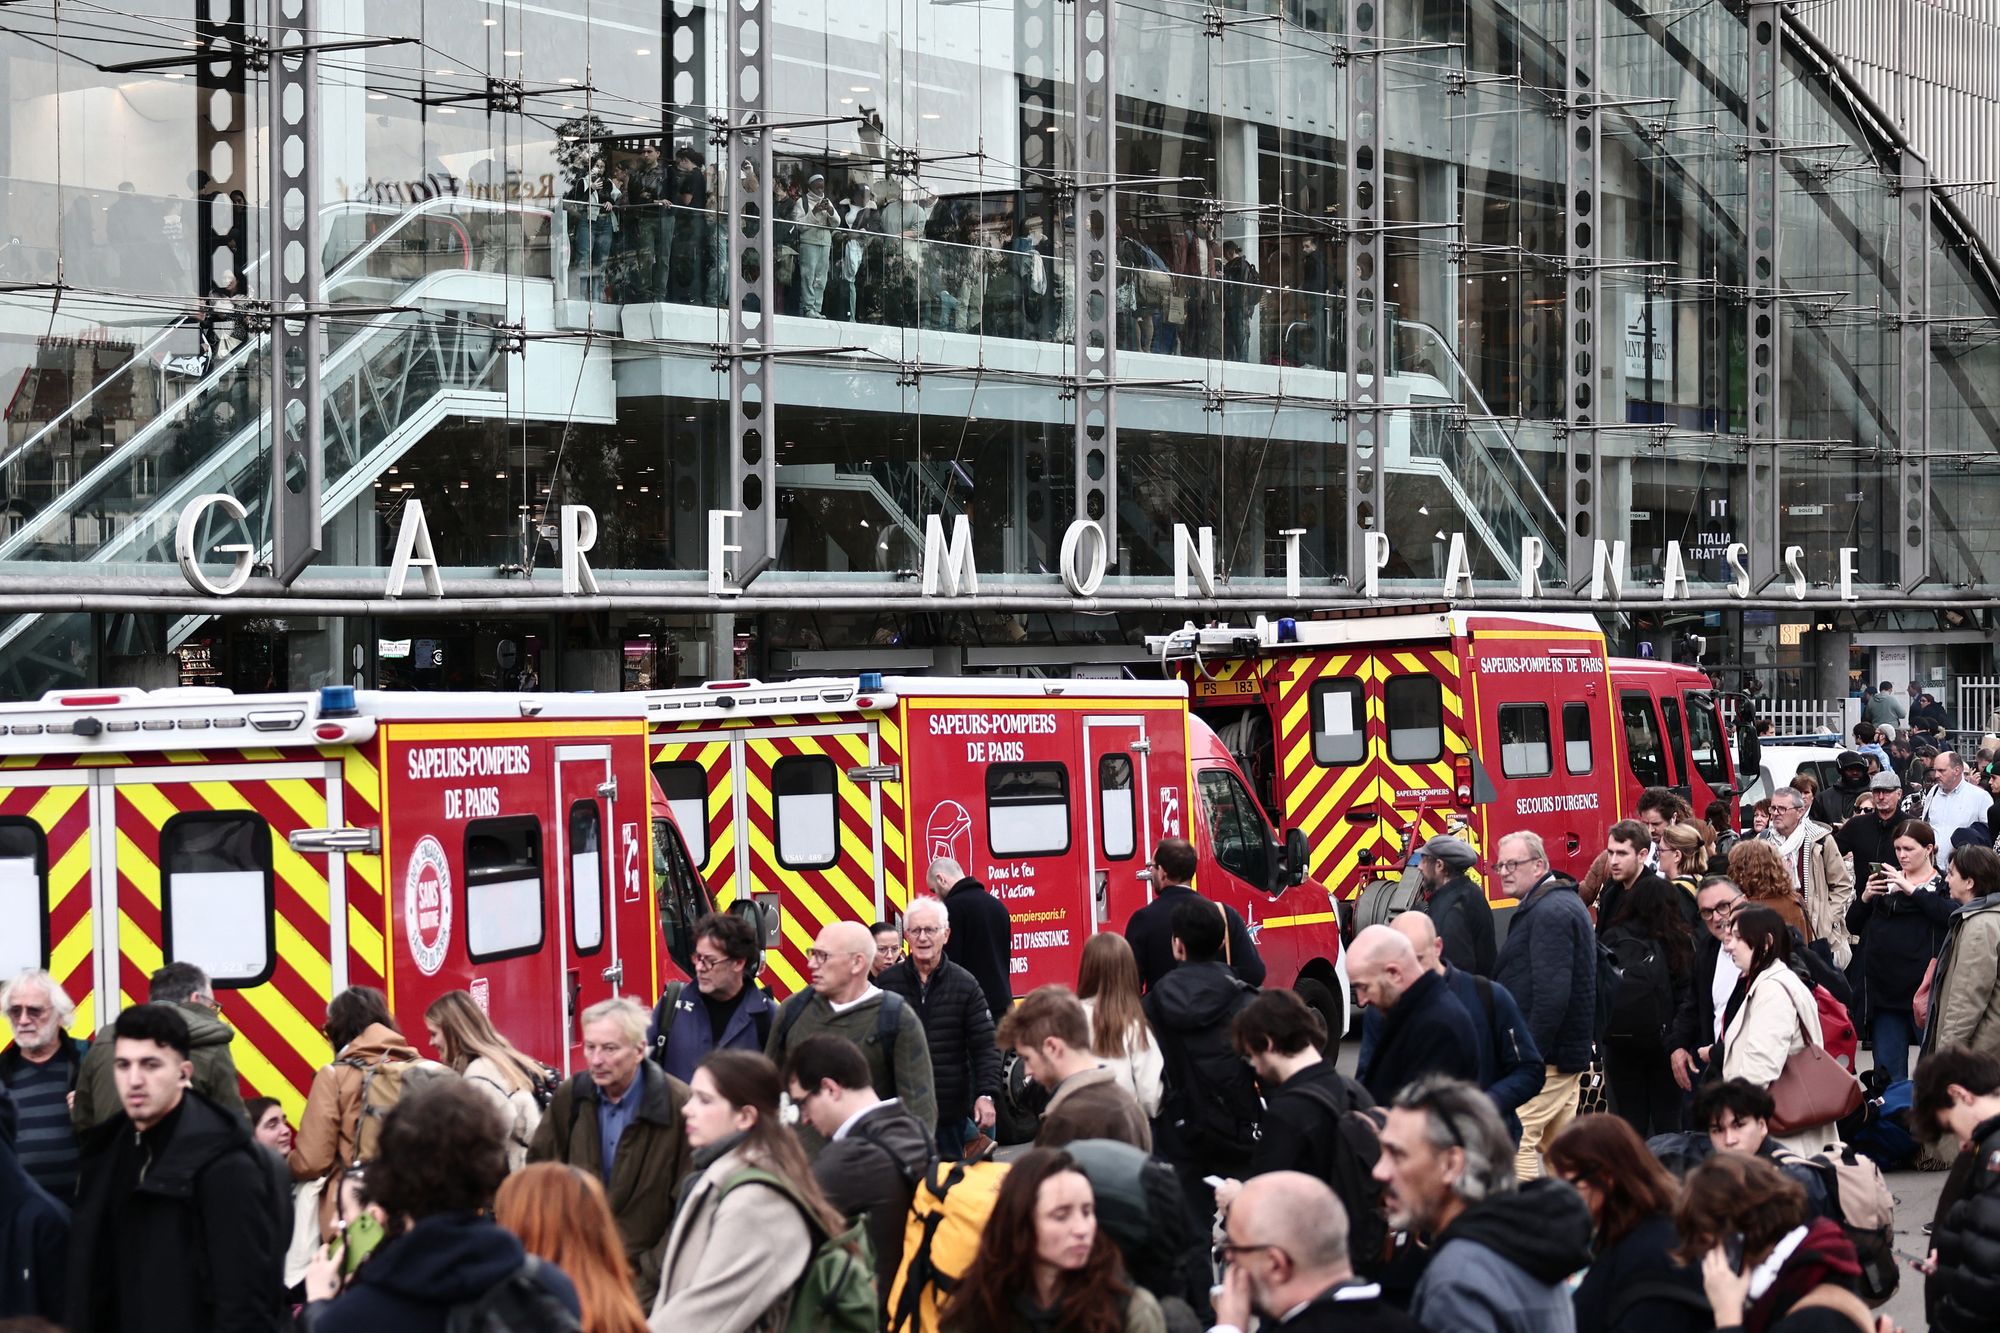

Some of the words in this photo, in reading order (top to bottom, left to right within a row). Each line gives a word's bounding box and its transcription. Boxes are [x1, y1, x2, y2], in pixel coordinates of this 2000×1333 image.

[1710, 500, 1728, 517] IT
[175, 493, 743, 598] GARE
[921, 513, 1859, 602] MONTPARNASSE
[1698, 532, 1731, 545] ITALIA
[1480, 656, 1554, 674] SAPEURS-POMPIERS
[1566, 657, 1578, 673] DE
[1581, 656, 1604, 673] PARIS
[1880, 651, 1906, 661] Bienvenue
[1203, 683, 1217, 695] PS
[1235, 681, 1253, 693] 183
[929, 713, 1057, 735] SAPEURS-POMPIERS
[967, 742, 985, 762] DE
[988, 741, 1024, 762] PARIS
[408, 745, 530, 780] SAPEURS-POMPIERS
[1395, 788, 1450, 798] SAPEURS-POMPIERS
[444, 788, 463, 820] DE
[465, 787, 499, 818] PARIS
[1516, 796, 1553, 815] SECOURS
[1555, 793, 1599, 812] D'URGENCE
[988, 865, 1009, 880] Dans
[1011, 863, 1020, 878] le
[1021, 862, 1035, 877] feu
[418, 880, 440, 909] SANS
[1002, 884, 1036, 899] l'action
[1013, 933, 1023, 950] ET
[1023, 930, 1070, 949] D'ASSISTANCE
